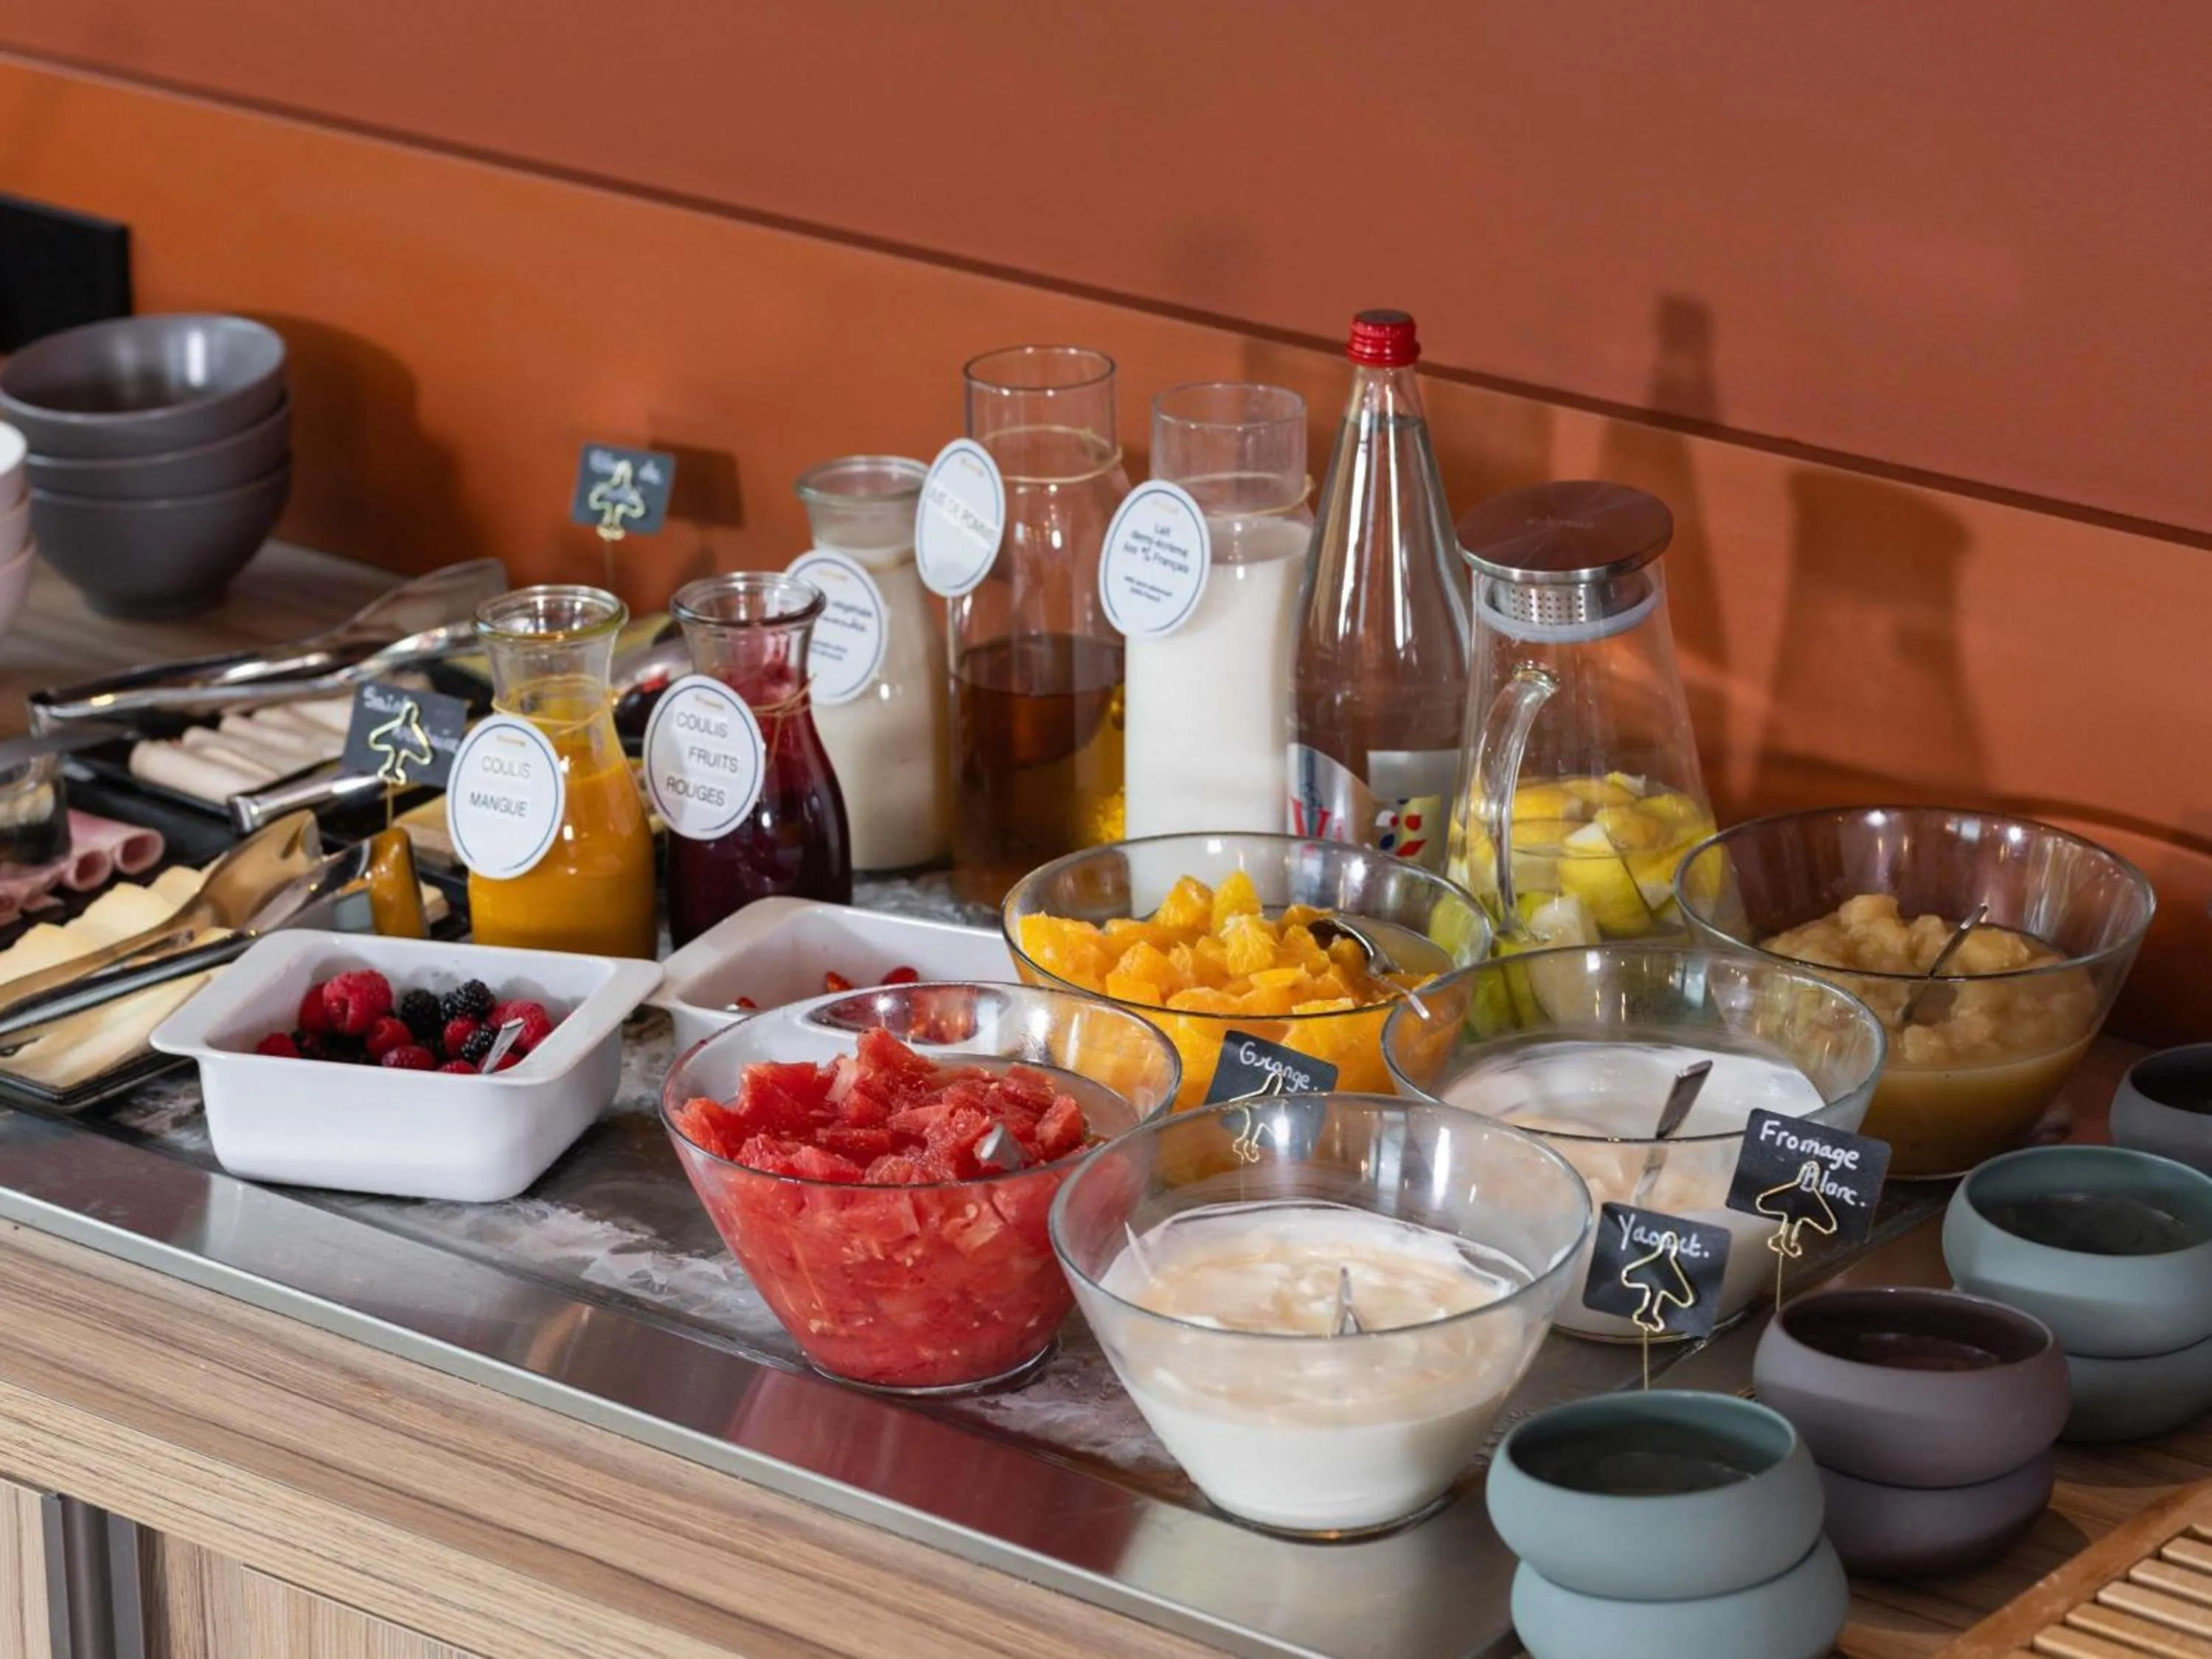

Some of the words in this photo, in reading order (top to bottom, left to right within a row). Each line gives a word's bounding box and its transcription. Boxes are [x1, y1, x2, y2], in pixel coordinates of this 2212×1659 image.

[676, 712, 728, 739] COULIS
[481, 755, 532, 779] COULIS
[688, 745, 739, 773] FRUITS
[469, 791, 528, 817] MANGUE
[666, 775, 726, 807] ROUGES
[1759, 1119, 1860, 1171] Fromage
